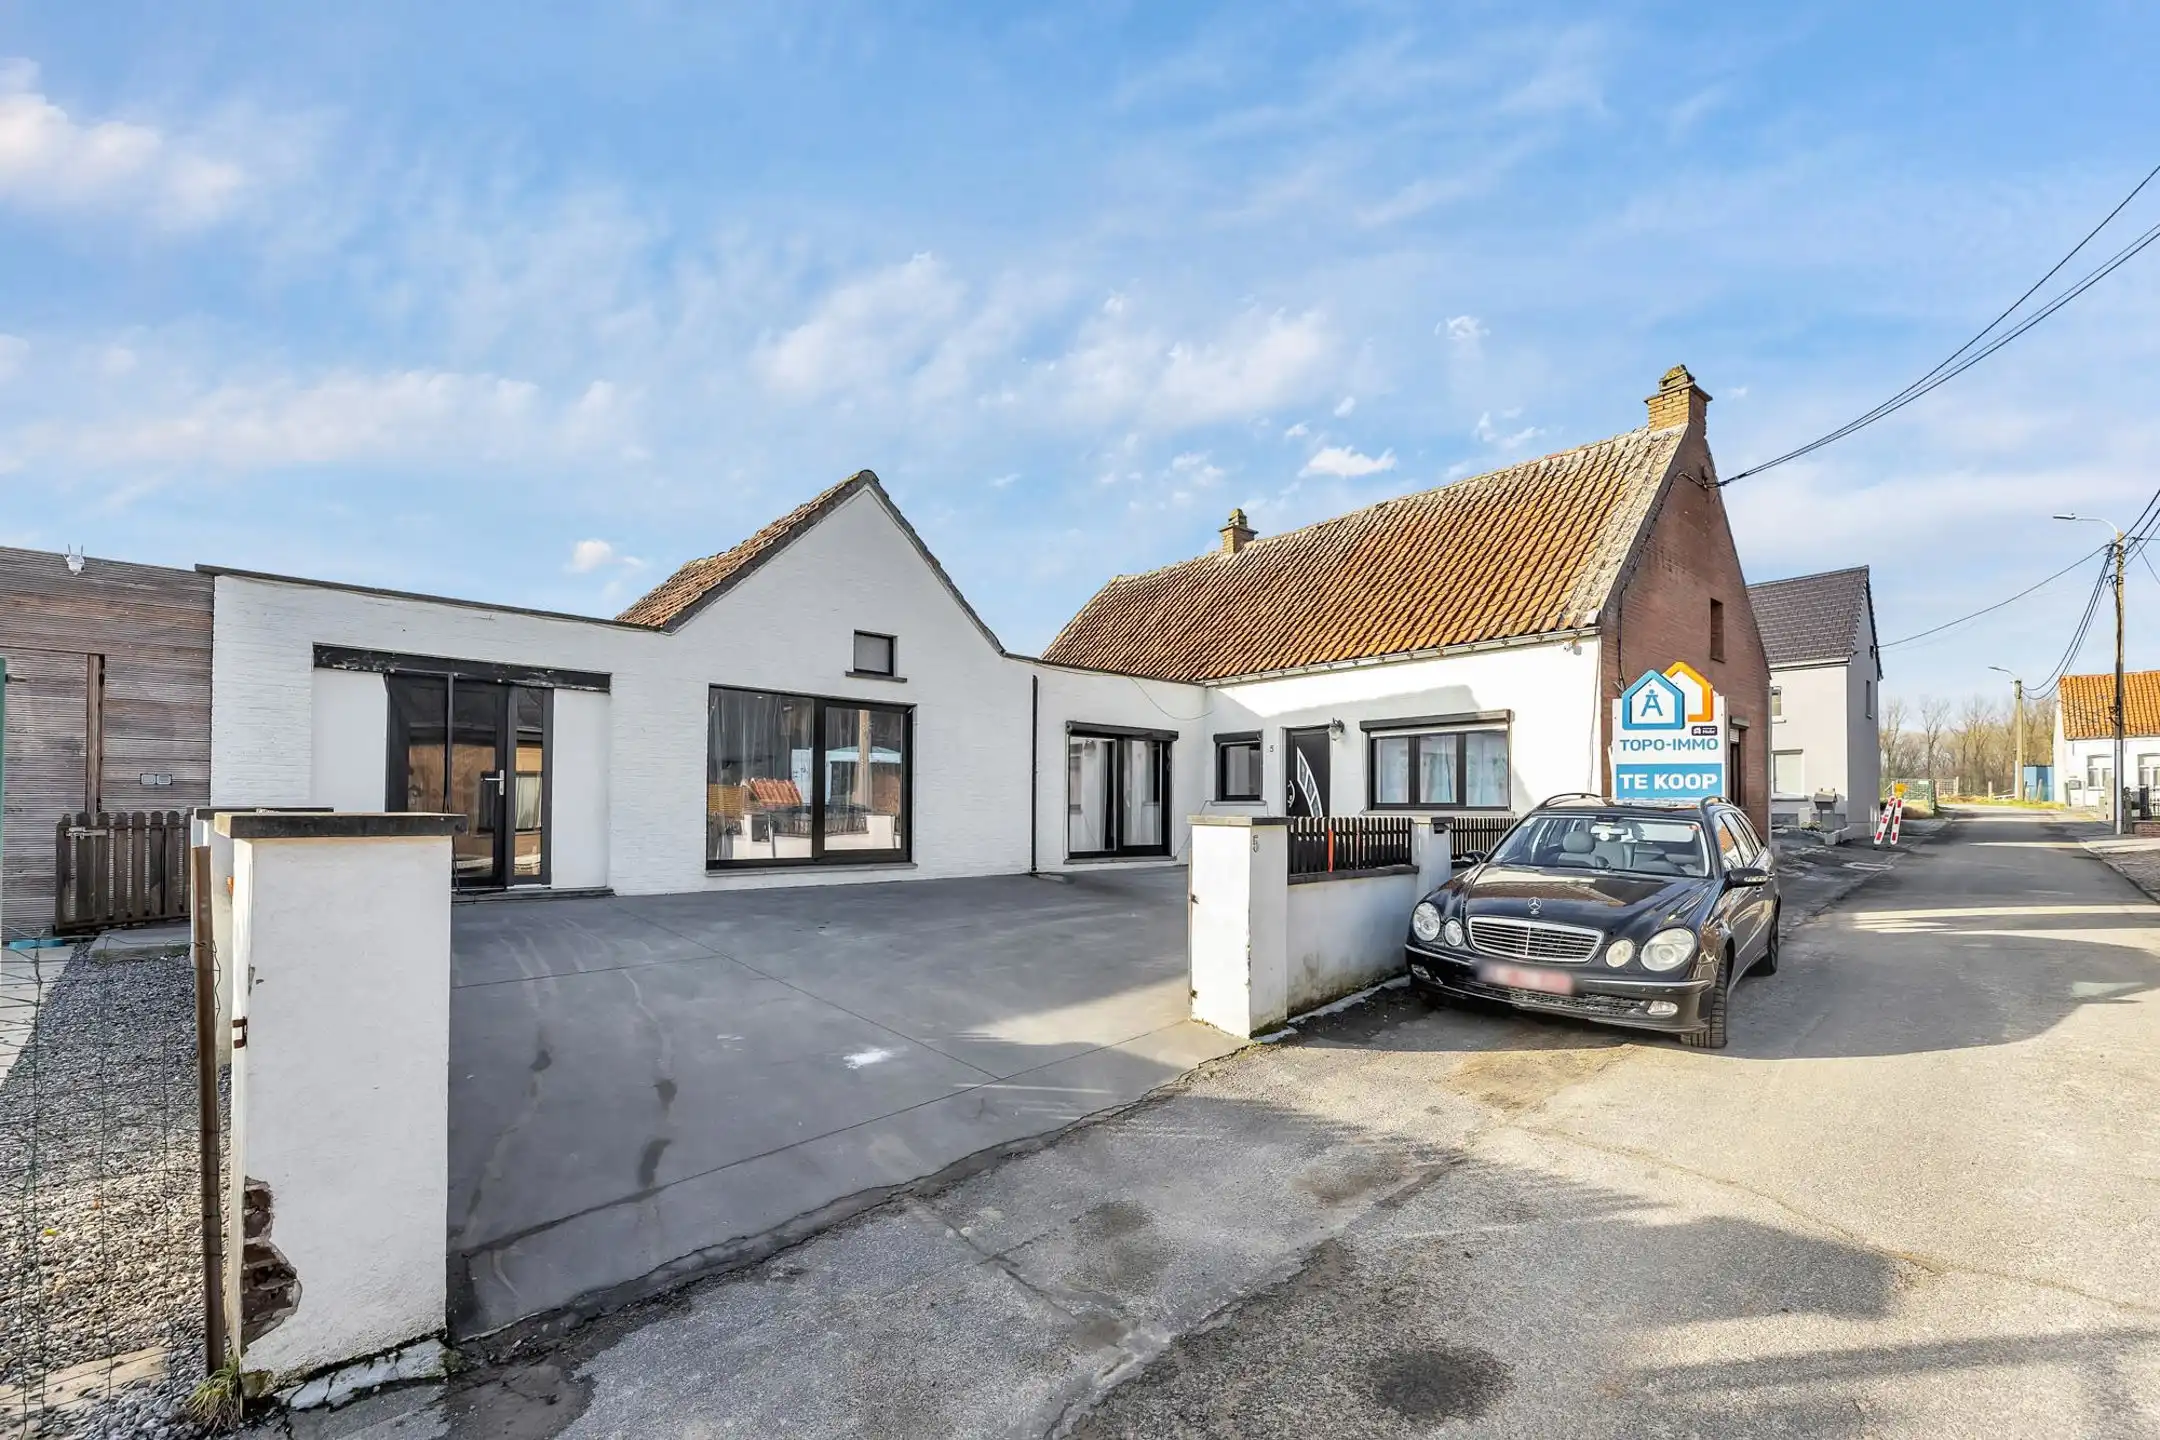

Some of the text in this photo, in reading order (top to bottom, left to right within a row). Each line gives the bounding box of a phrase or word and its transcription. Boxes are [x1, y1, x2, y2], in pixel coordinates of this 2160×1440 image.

[1620, 738, 1718, 751] TOPO-IMMO
[1619, 773, 1718, 790] TE KOOP
